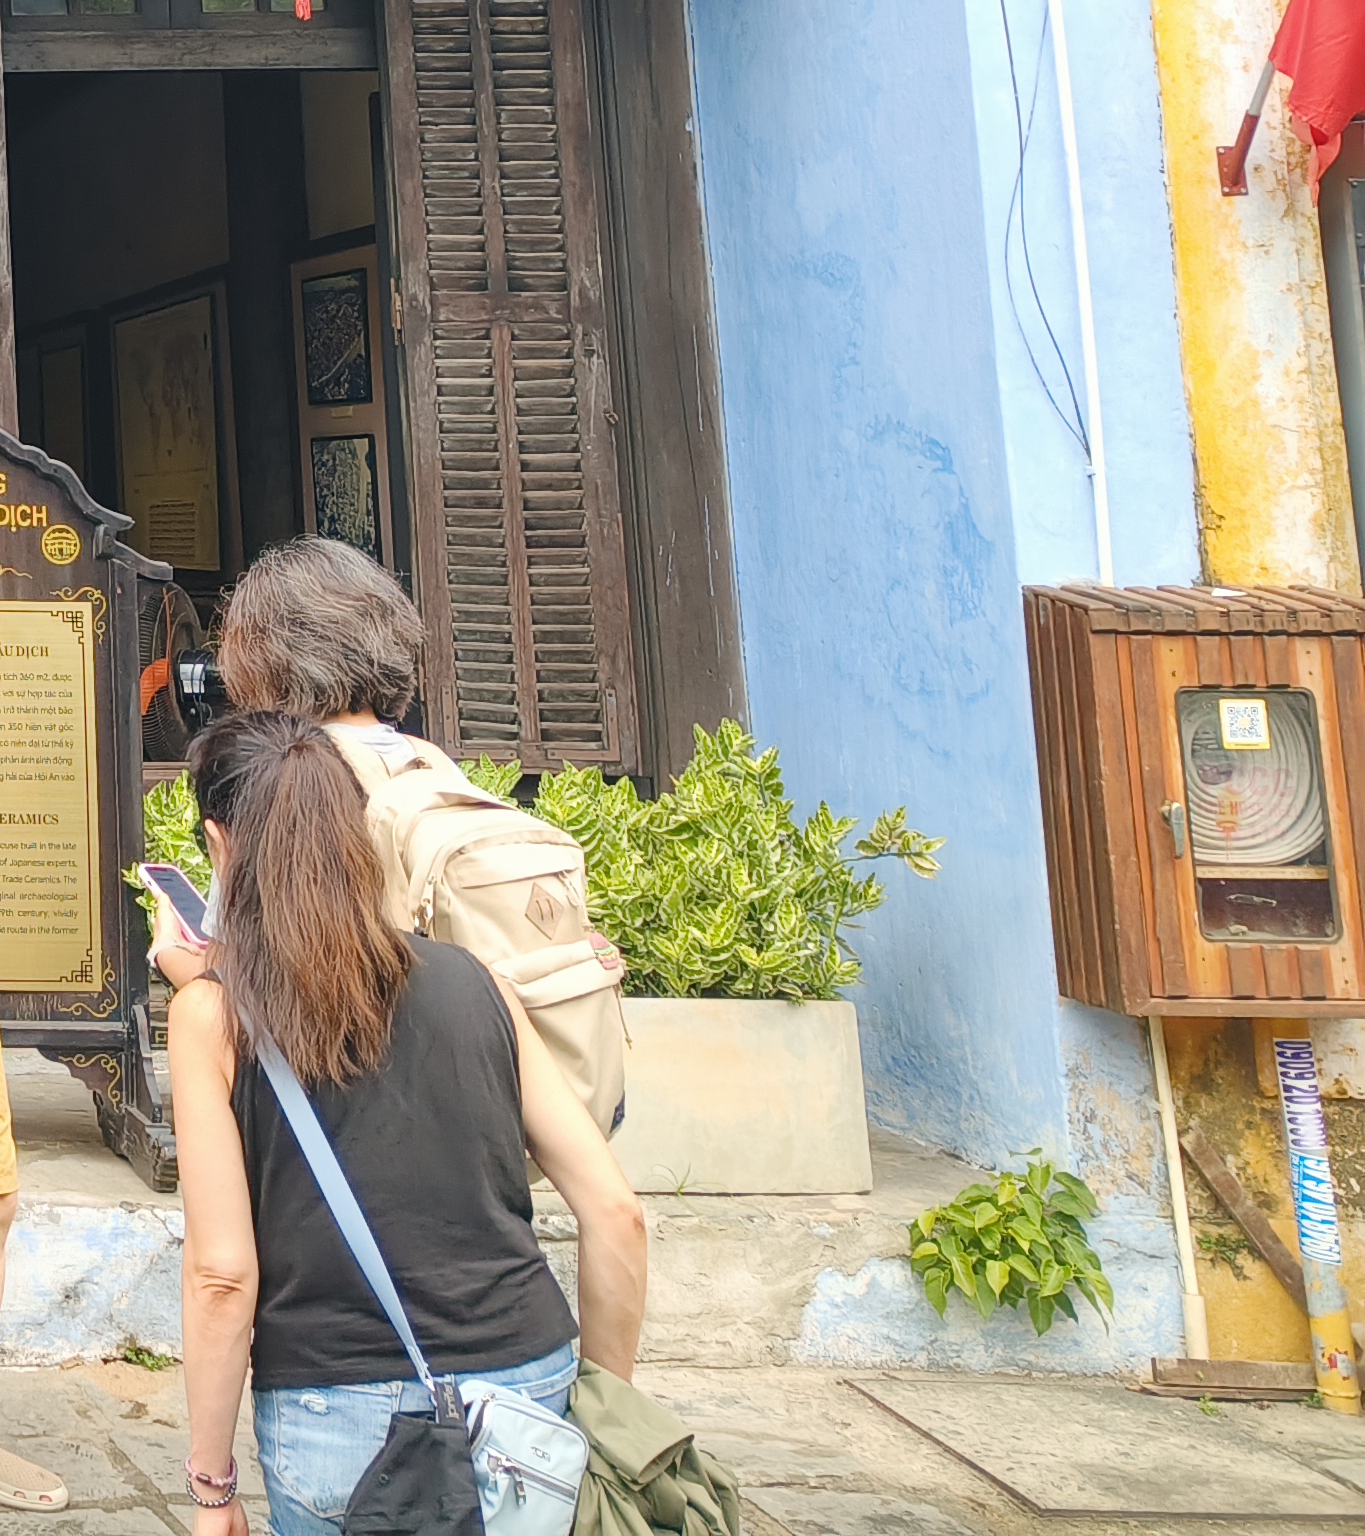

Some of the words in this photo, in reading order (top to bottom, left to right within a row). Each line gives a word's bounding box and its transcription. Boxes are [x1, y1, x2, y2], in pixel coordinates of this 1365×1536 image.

[16, 645, 50, 659] DỊCH
[48, 842, 61, 850] the
[2, 875, 23, 883] Trade
[64, 875, 77, 884] The
[19, 892, 78, 902] archaeological
[37, 926, 50, 934] the
